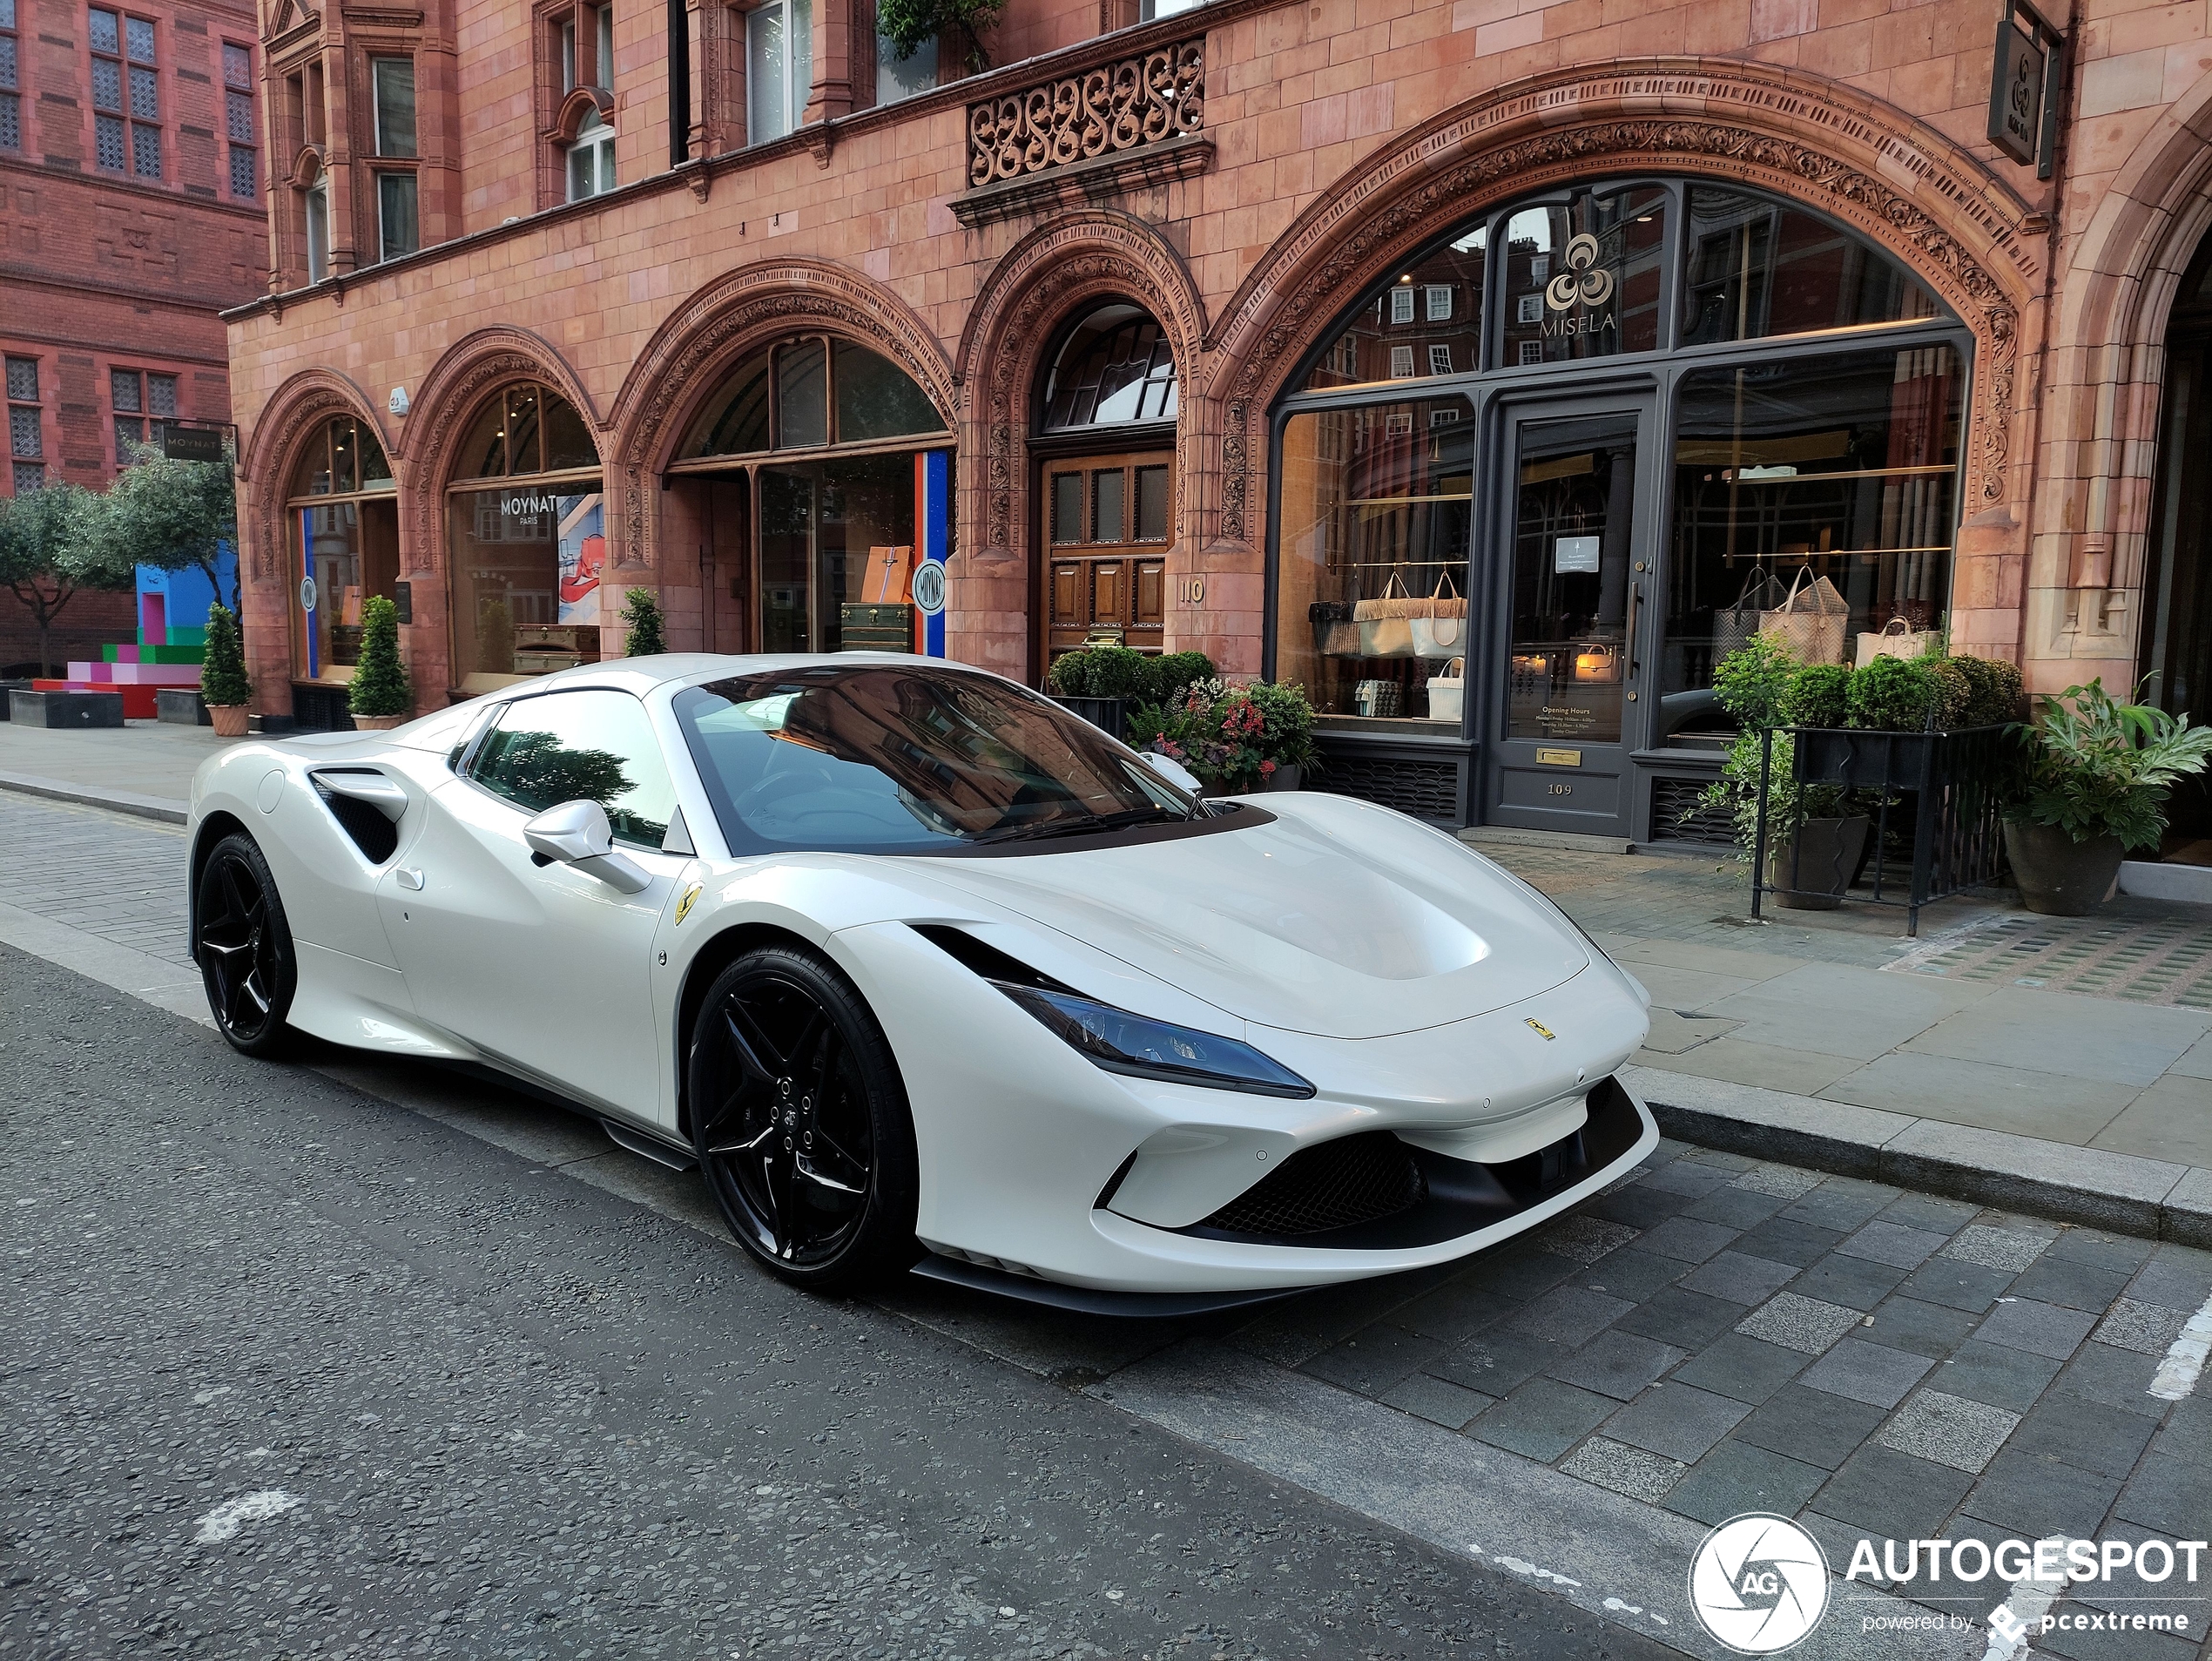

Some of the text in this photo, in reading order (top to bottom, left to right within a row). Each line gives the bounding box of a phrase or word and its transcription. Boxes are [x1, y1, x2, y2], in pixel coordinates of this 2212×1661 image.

[1539, 313, 1616, 339] MISELA
[167, 438, 216, 449] MOYNAT
[501, 495, 556, 516] MOYNAT
[519, 517, 538, 525] PARIS
[1180, 579, 1204, 603] 110
[1542, 706, 1569, 715] Opening
[1548, 784, 1572, 795] 109
